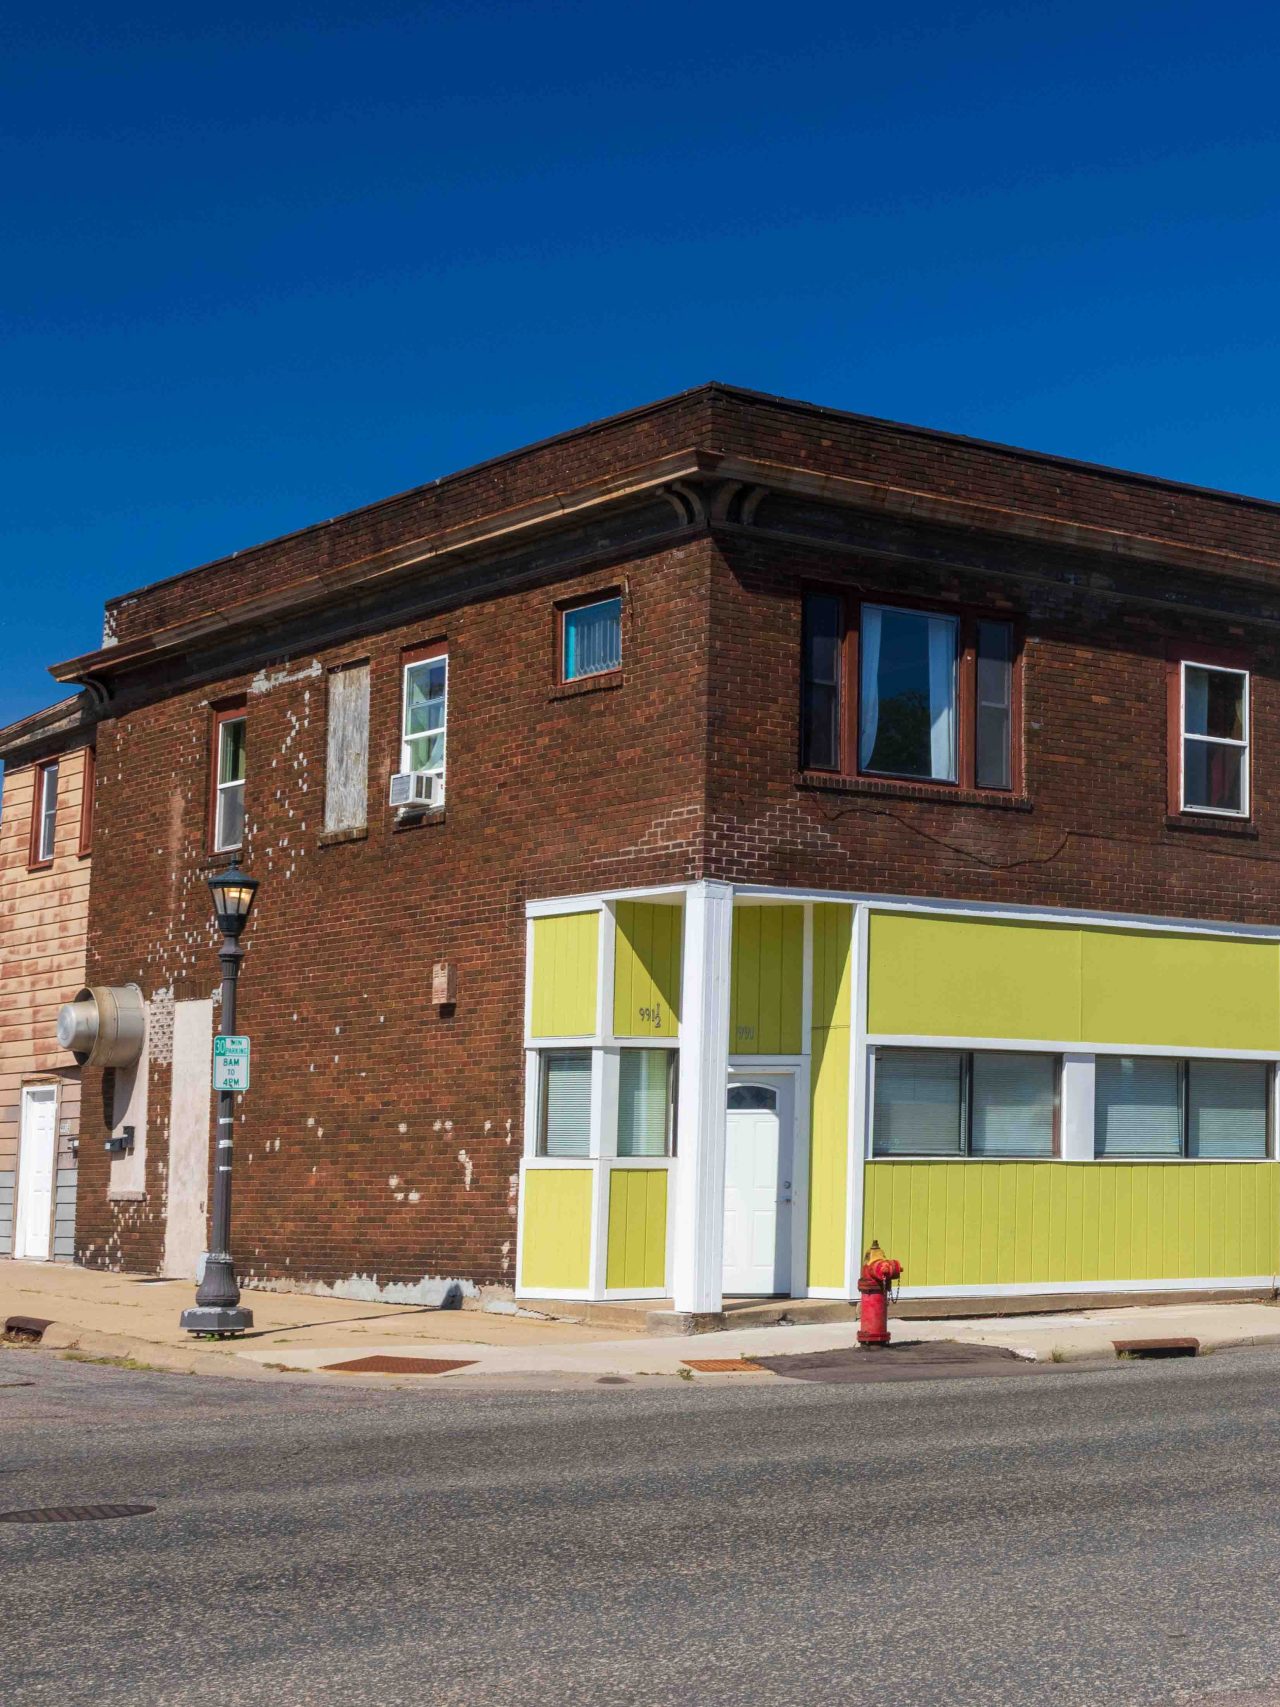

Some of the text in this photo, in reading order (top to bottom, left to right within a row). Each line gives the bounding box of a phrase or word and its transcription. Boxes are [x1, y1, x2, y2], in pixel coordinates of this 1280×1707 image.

[215, 1040, 225, 1054] 30
[223, 1058, 240, 1067] 8AM
[227, 1068, 235, 1076] TO
[223, 1078, 240, 1087] 4PM
